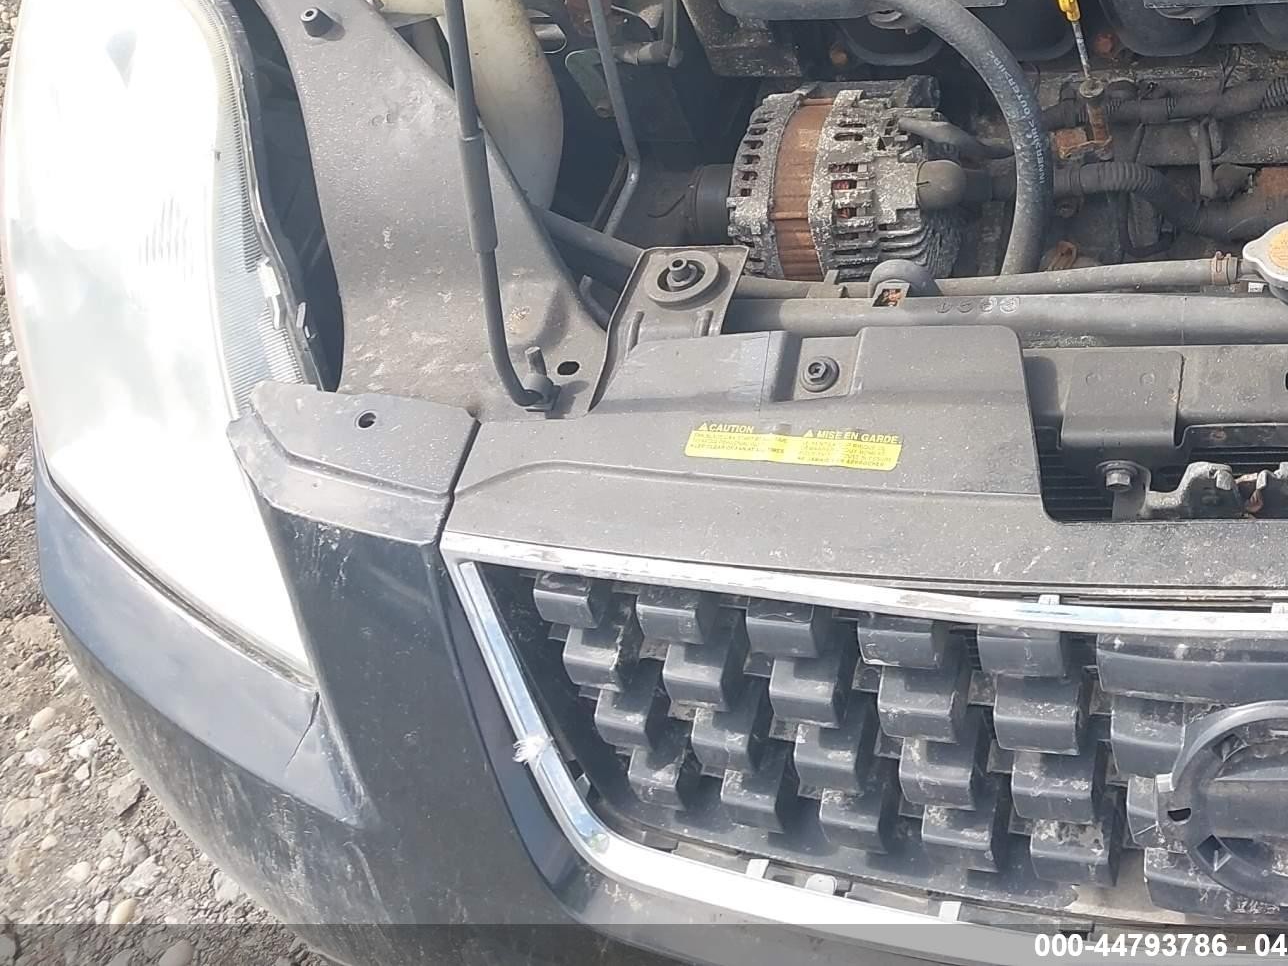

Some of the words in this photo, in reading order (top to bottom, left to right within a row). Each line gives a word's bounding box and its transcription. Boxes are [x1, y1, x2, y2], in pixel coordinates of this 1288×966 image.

[709, 423, 754, 434] CAUTION
[816, 430, 843, 439] MISE
[844, 432, 859, 440] EN
